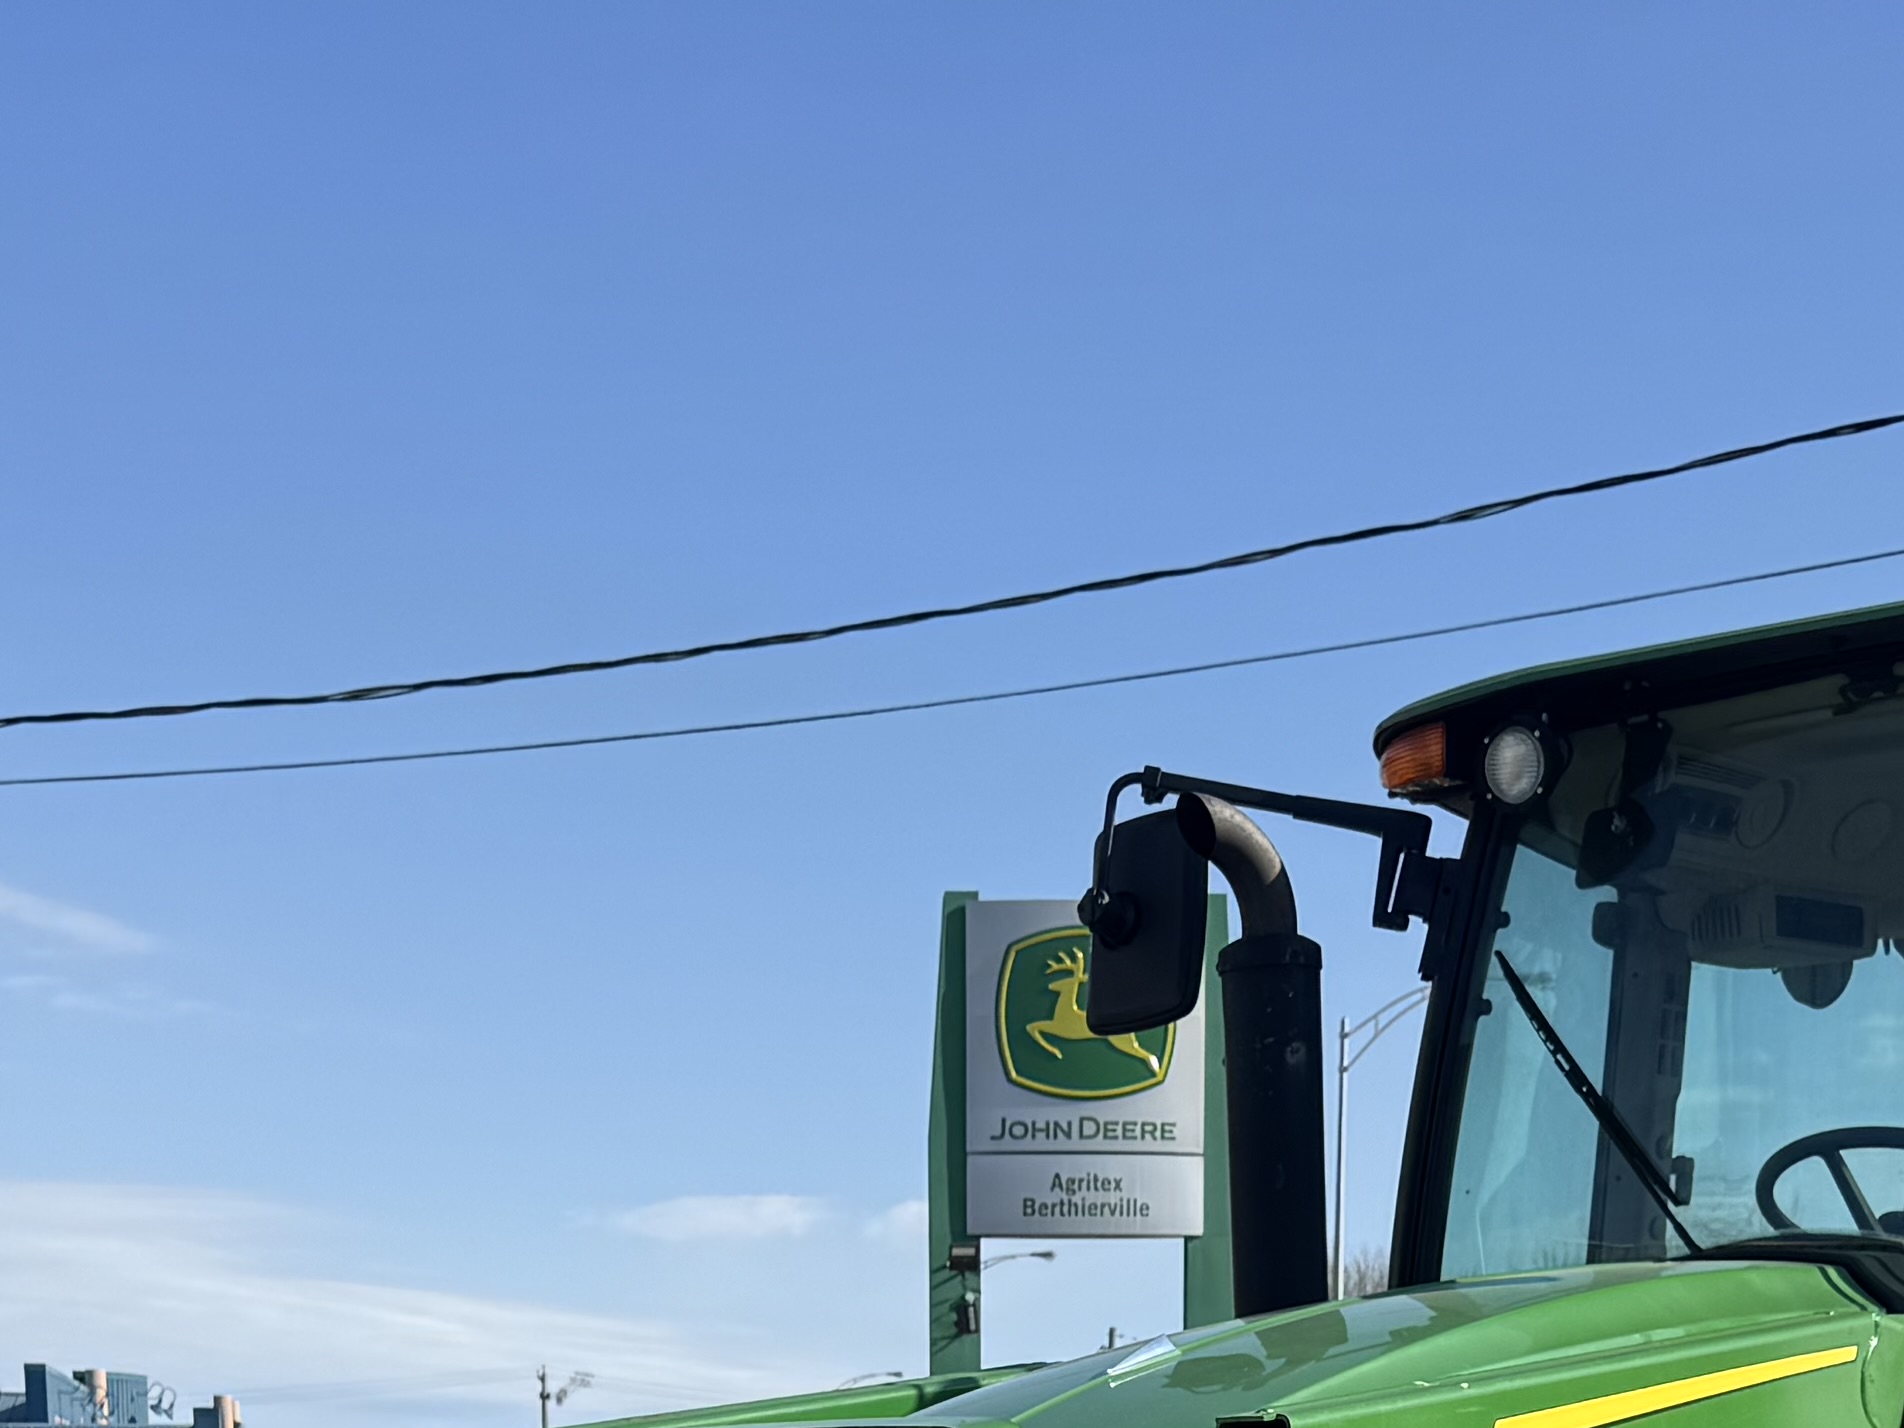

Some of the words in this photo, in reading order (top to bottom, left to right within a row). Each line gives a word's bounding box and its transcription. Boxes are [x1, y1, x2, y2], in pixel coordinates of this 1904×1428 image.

[990, 1117, 1072, 1141] JOHN
[1079, 1117, 1177, 1141] DEERE
[1050, 1172, 1123, 1196] Agritex
[1022, 1197, 1150, 1218] Berthierville
